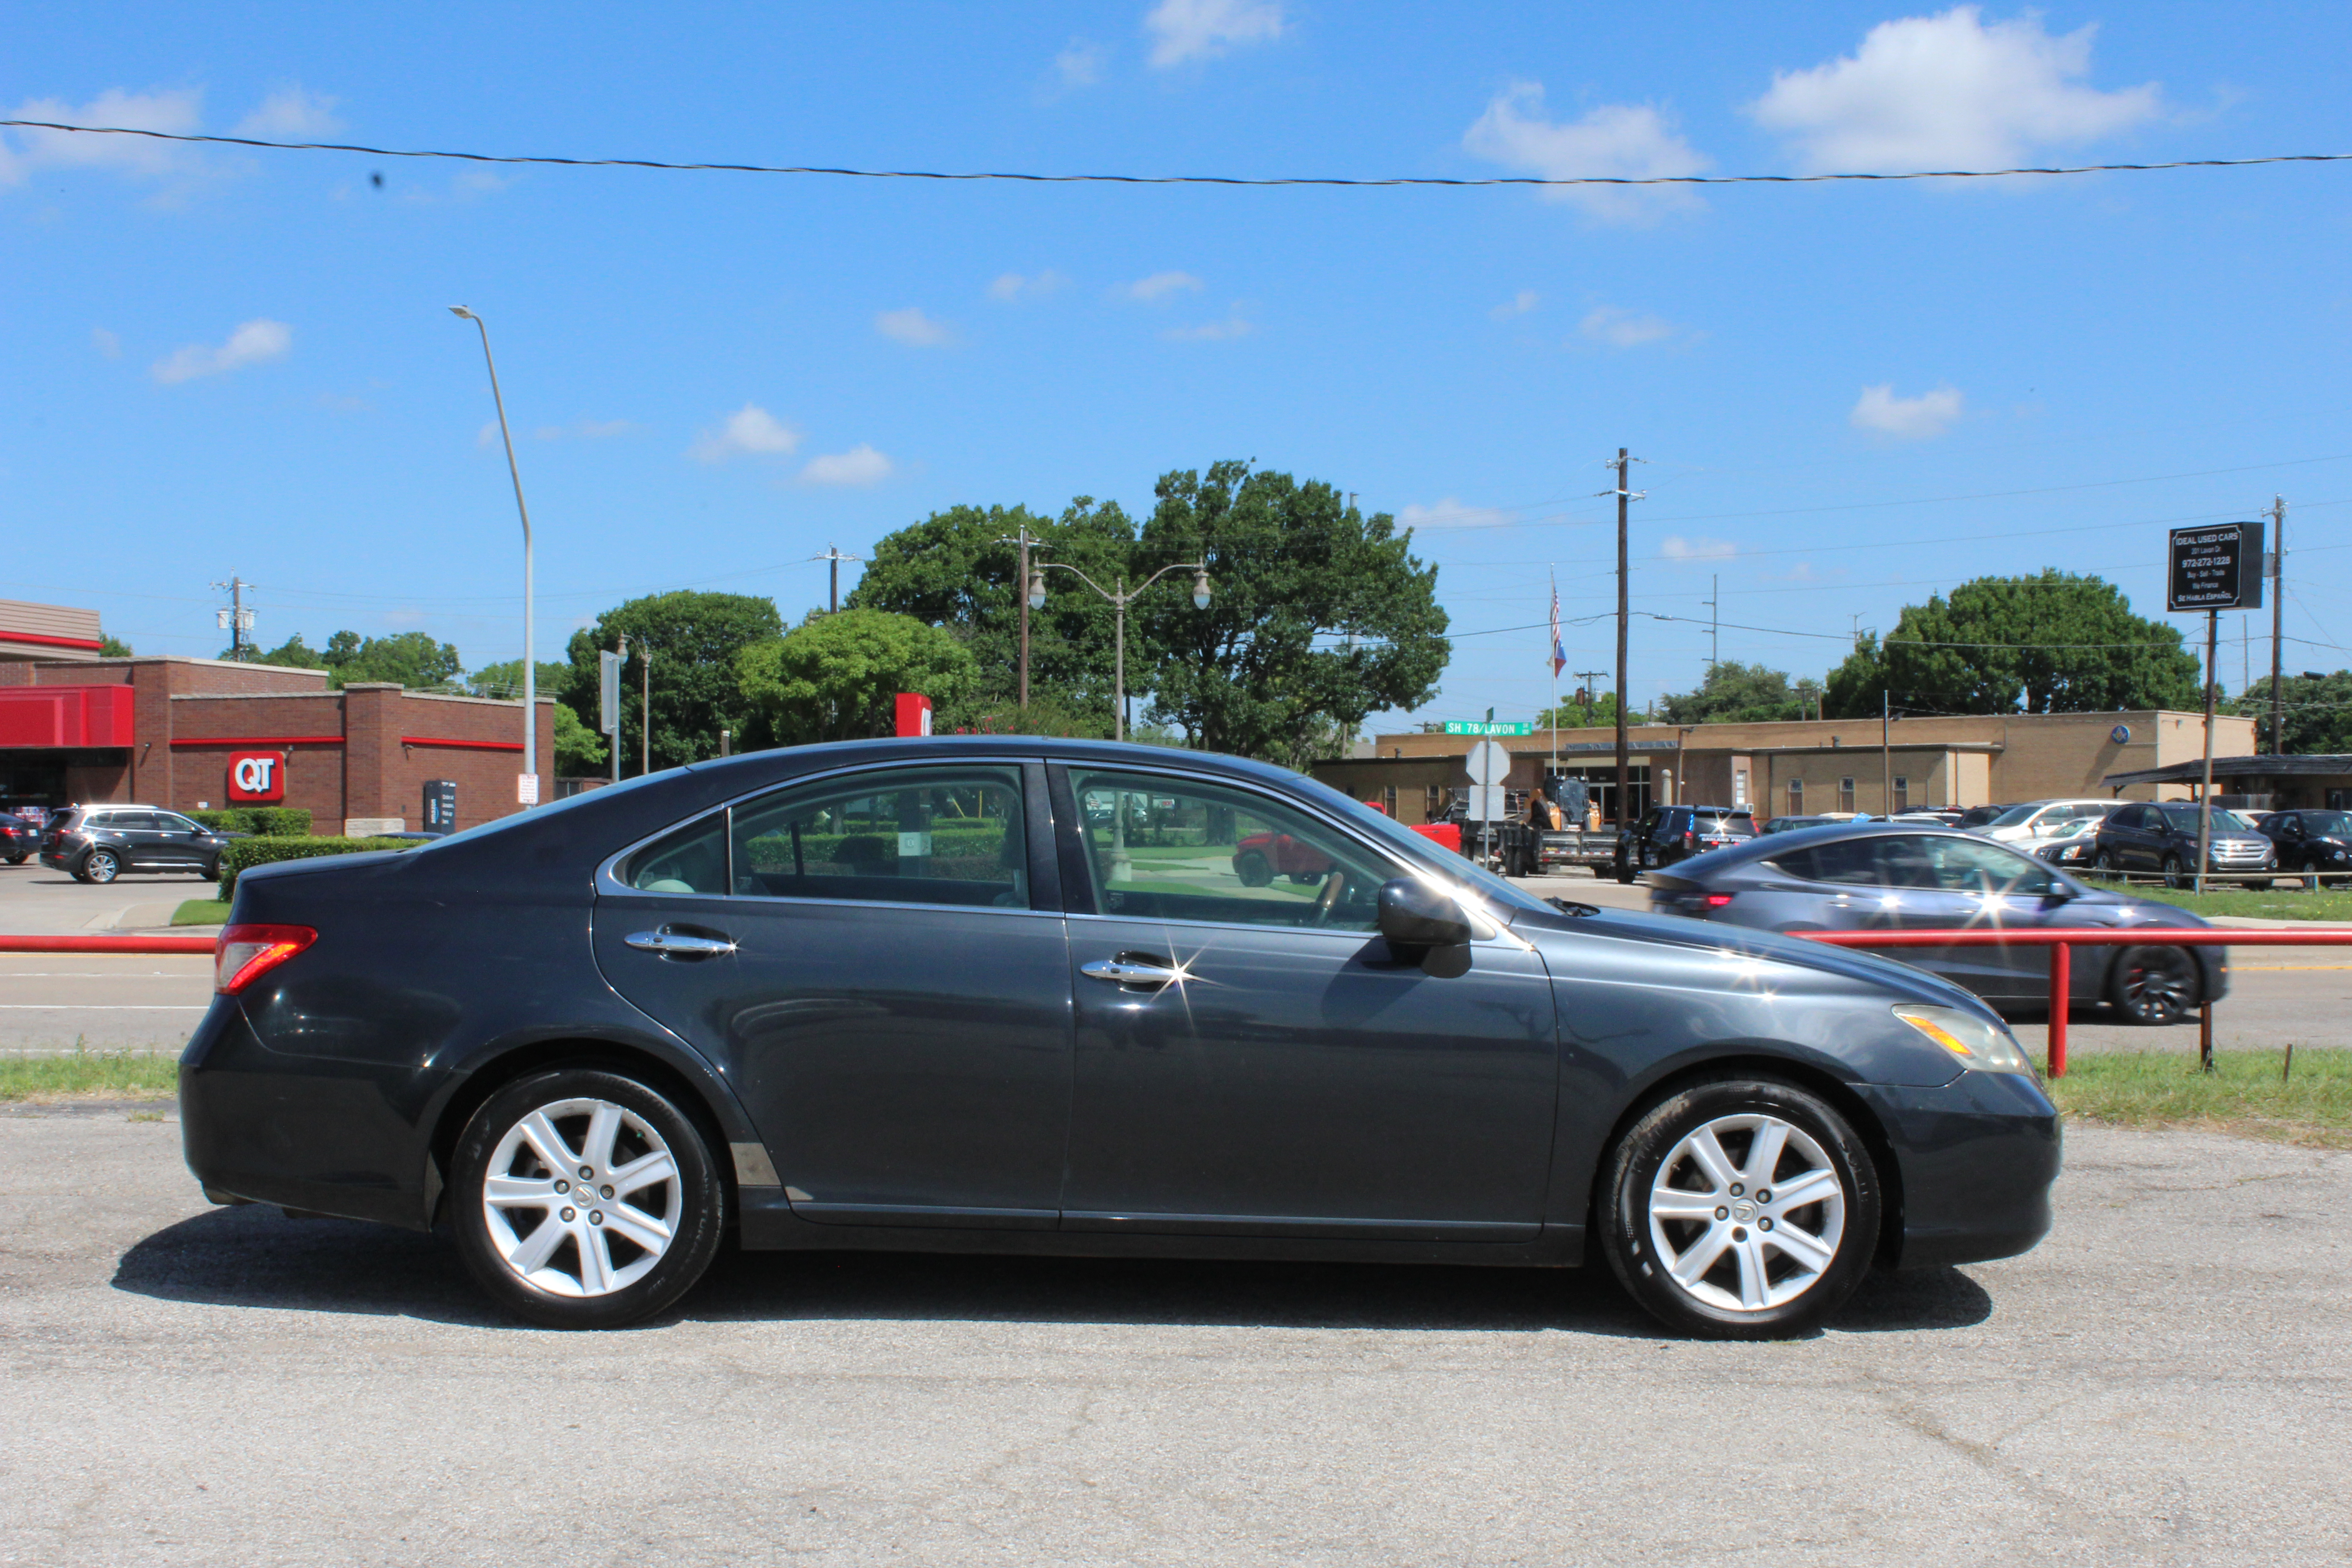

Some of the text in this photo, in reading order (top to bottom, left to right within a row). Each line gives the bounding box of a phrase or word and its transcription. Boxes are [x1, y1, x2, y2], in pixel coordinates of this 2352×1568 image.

[2176, 532, 2238, 546] IDEAL USED CARS
[1448, 723, 1515, 734] SH 78/LAVON
[235, 758, 274, 793] QT
